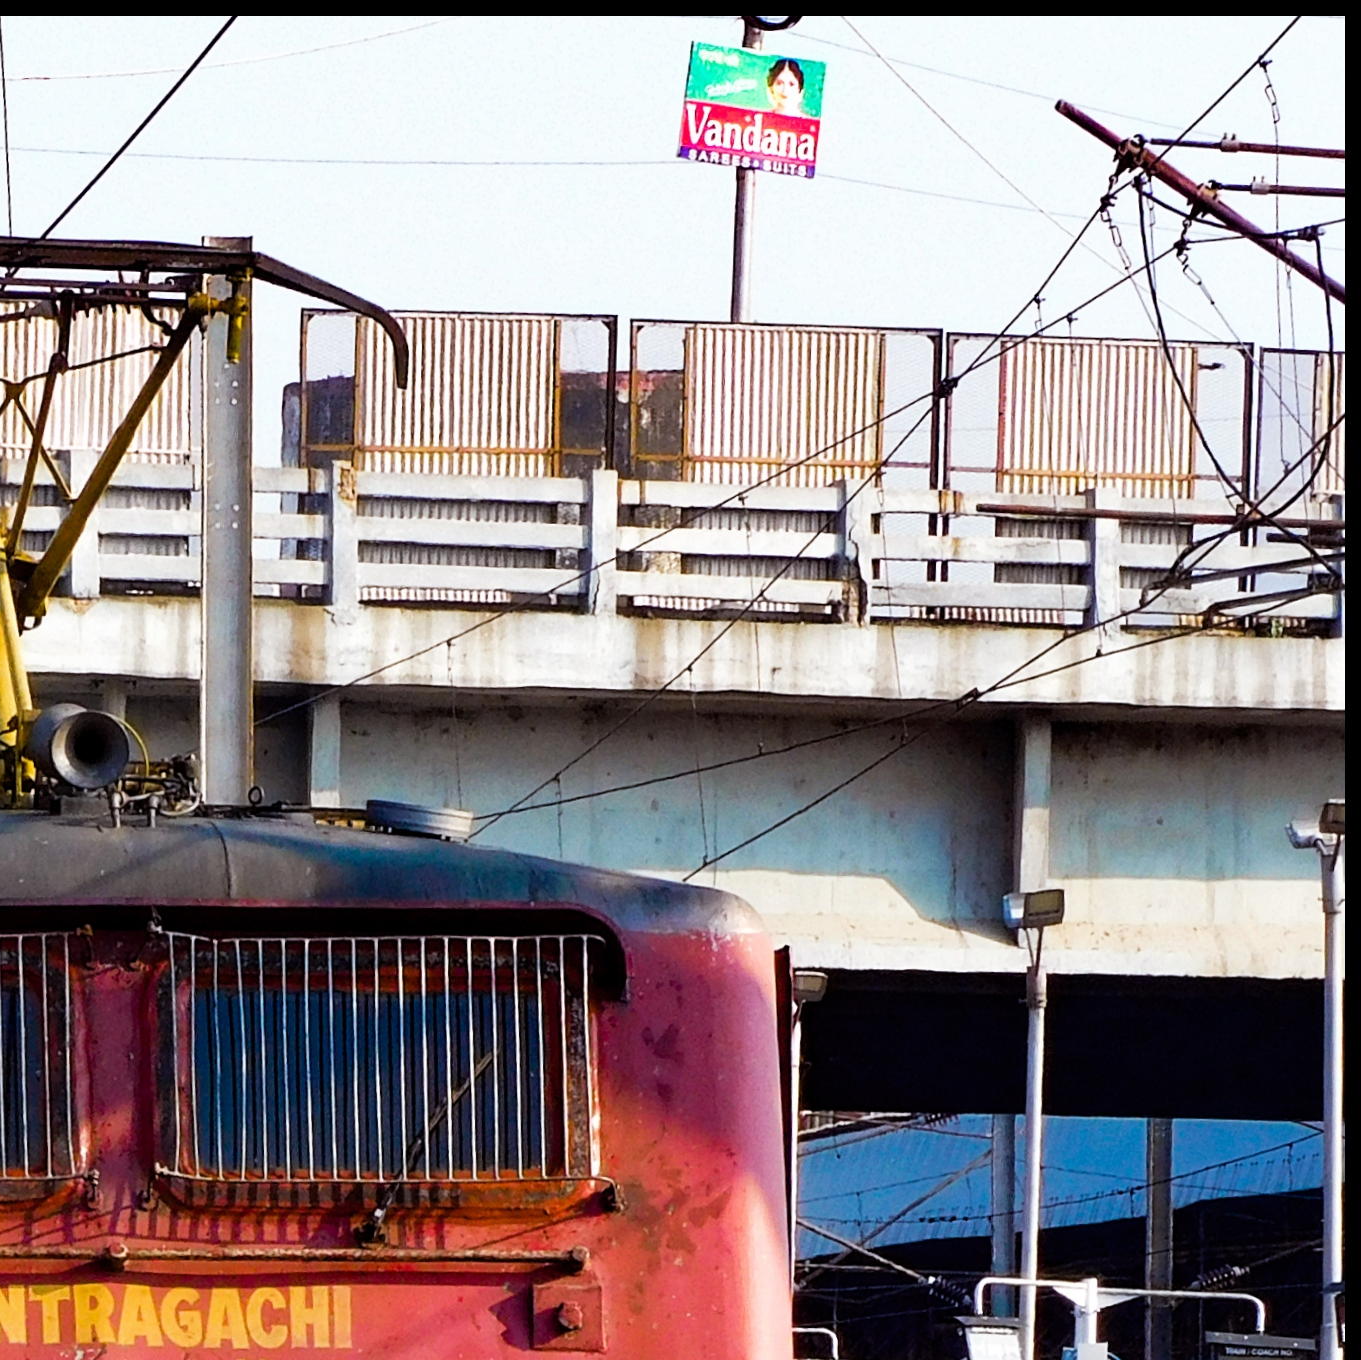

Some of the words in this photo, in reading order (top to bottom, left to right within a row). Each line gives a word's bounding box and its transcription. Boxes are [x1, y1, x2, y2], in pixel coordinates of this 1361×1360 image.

[686, 103, 815, 161] Vandana
[688, 148, 751, 168] SAREES
[763, 160, 807, 177] SUITS
